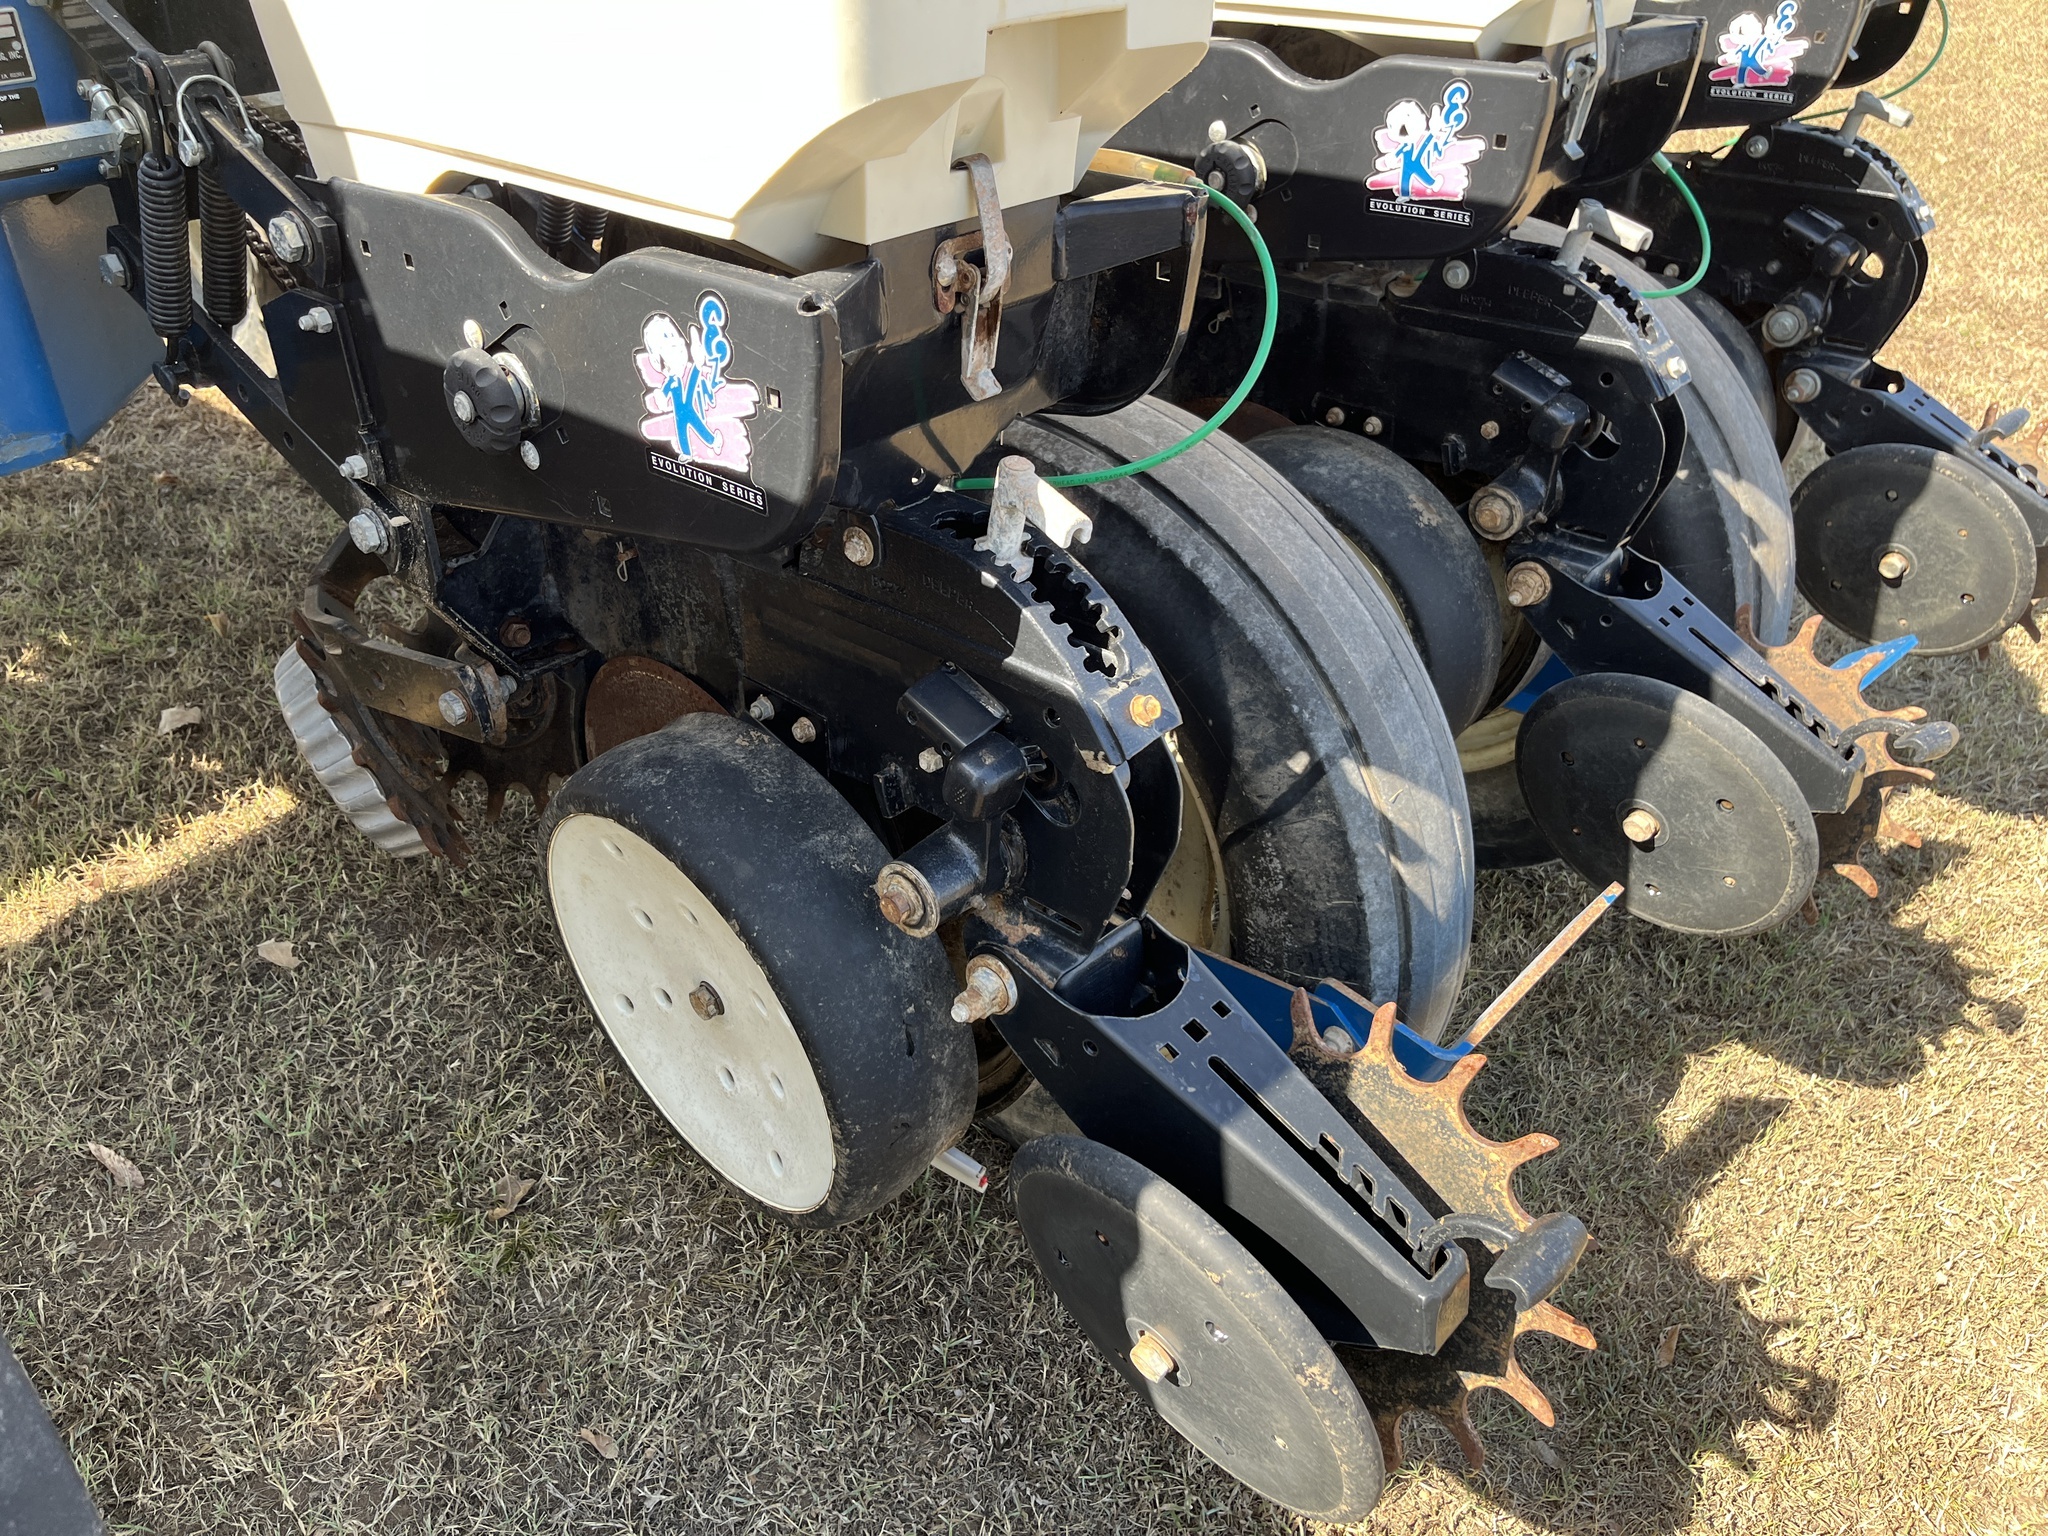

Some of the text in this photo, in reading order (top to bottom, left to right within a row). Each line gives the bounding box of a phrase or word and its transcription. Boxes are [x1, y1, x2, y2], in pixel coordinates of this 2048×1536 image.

[8, 50, 23, 60] INC.
[1710, 88, 1794, 102] EVOLUTION SERIES
[1369, 200, 1471, 223] EVOLUTION SERIES
[651, 454, 764, 506] EVOLUTION SERIES
